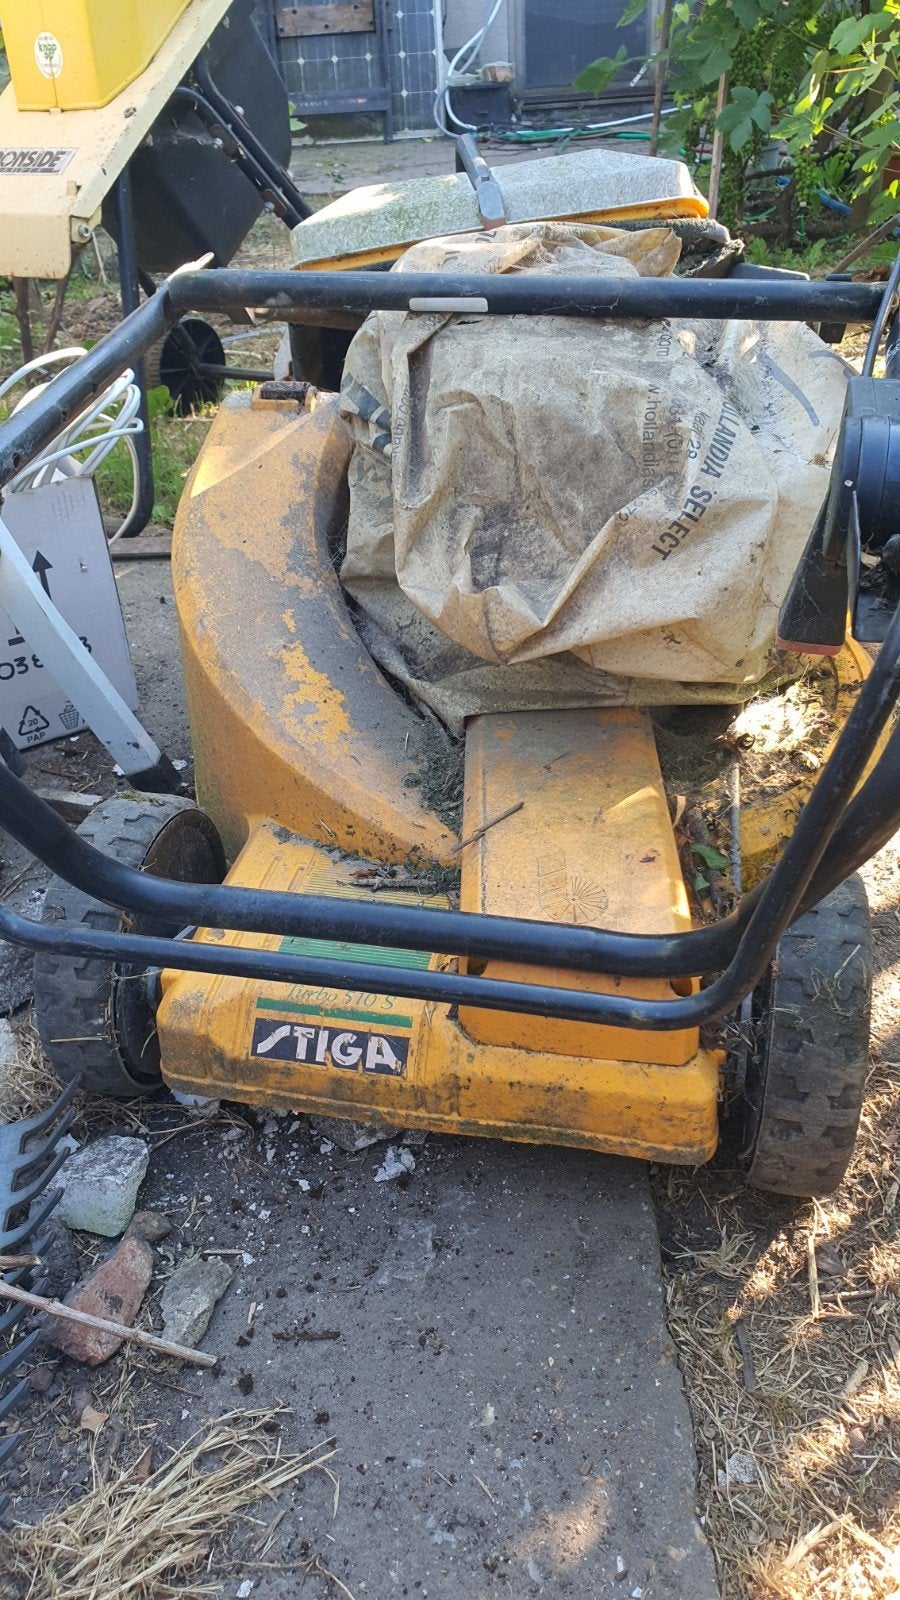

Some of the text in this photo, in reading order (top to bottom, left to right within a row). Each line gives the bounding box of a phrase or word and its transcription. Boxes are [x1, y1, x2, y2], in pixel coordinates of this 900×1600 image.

[651, 399, 740, 561] OLLANDIA SELECT
[28, 718, 39, 727] 20
[27, 732, 46, 744] PAP
[287, 984, 397, 1010] Turbo 510 S
[257, 1026, 401, 1075] STIGA
